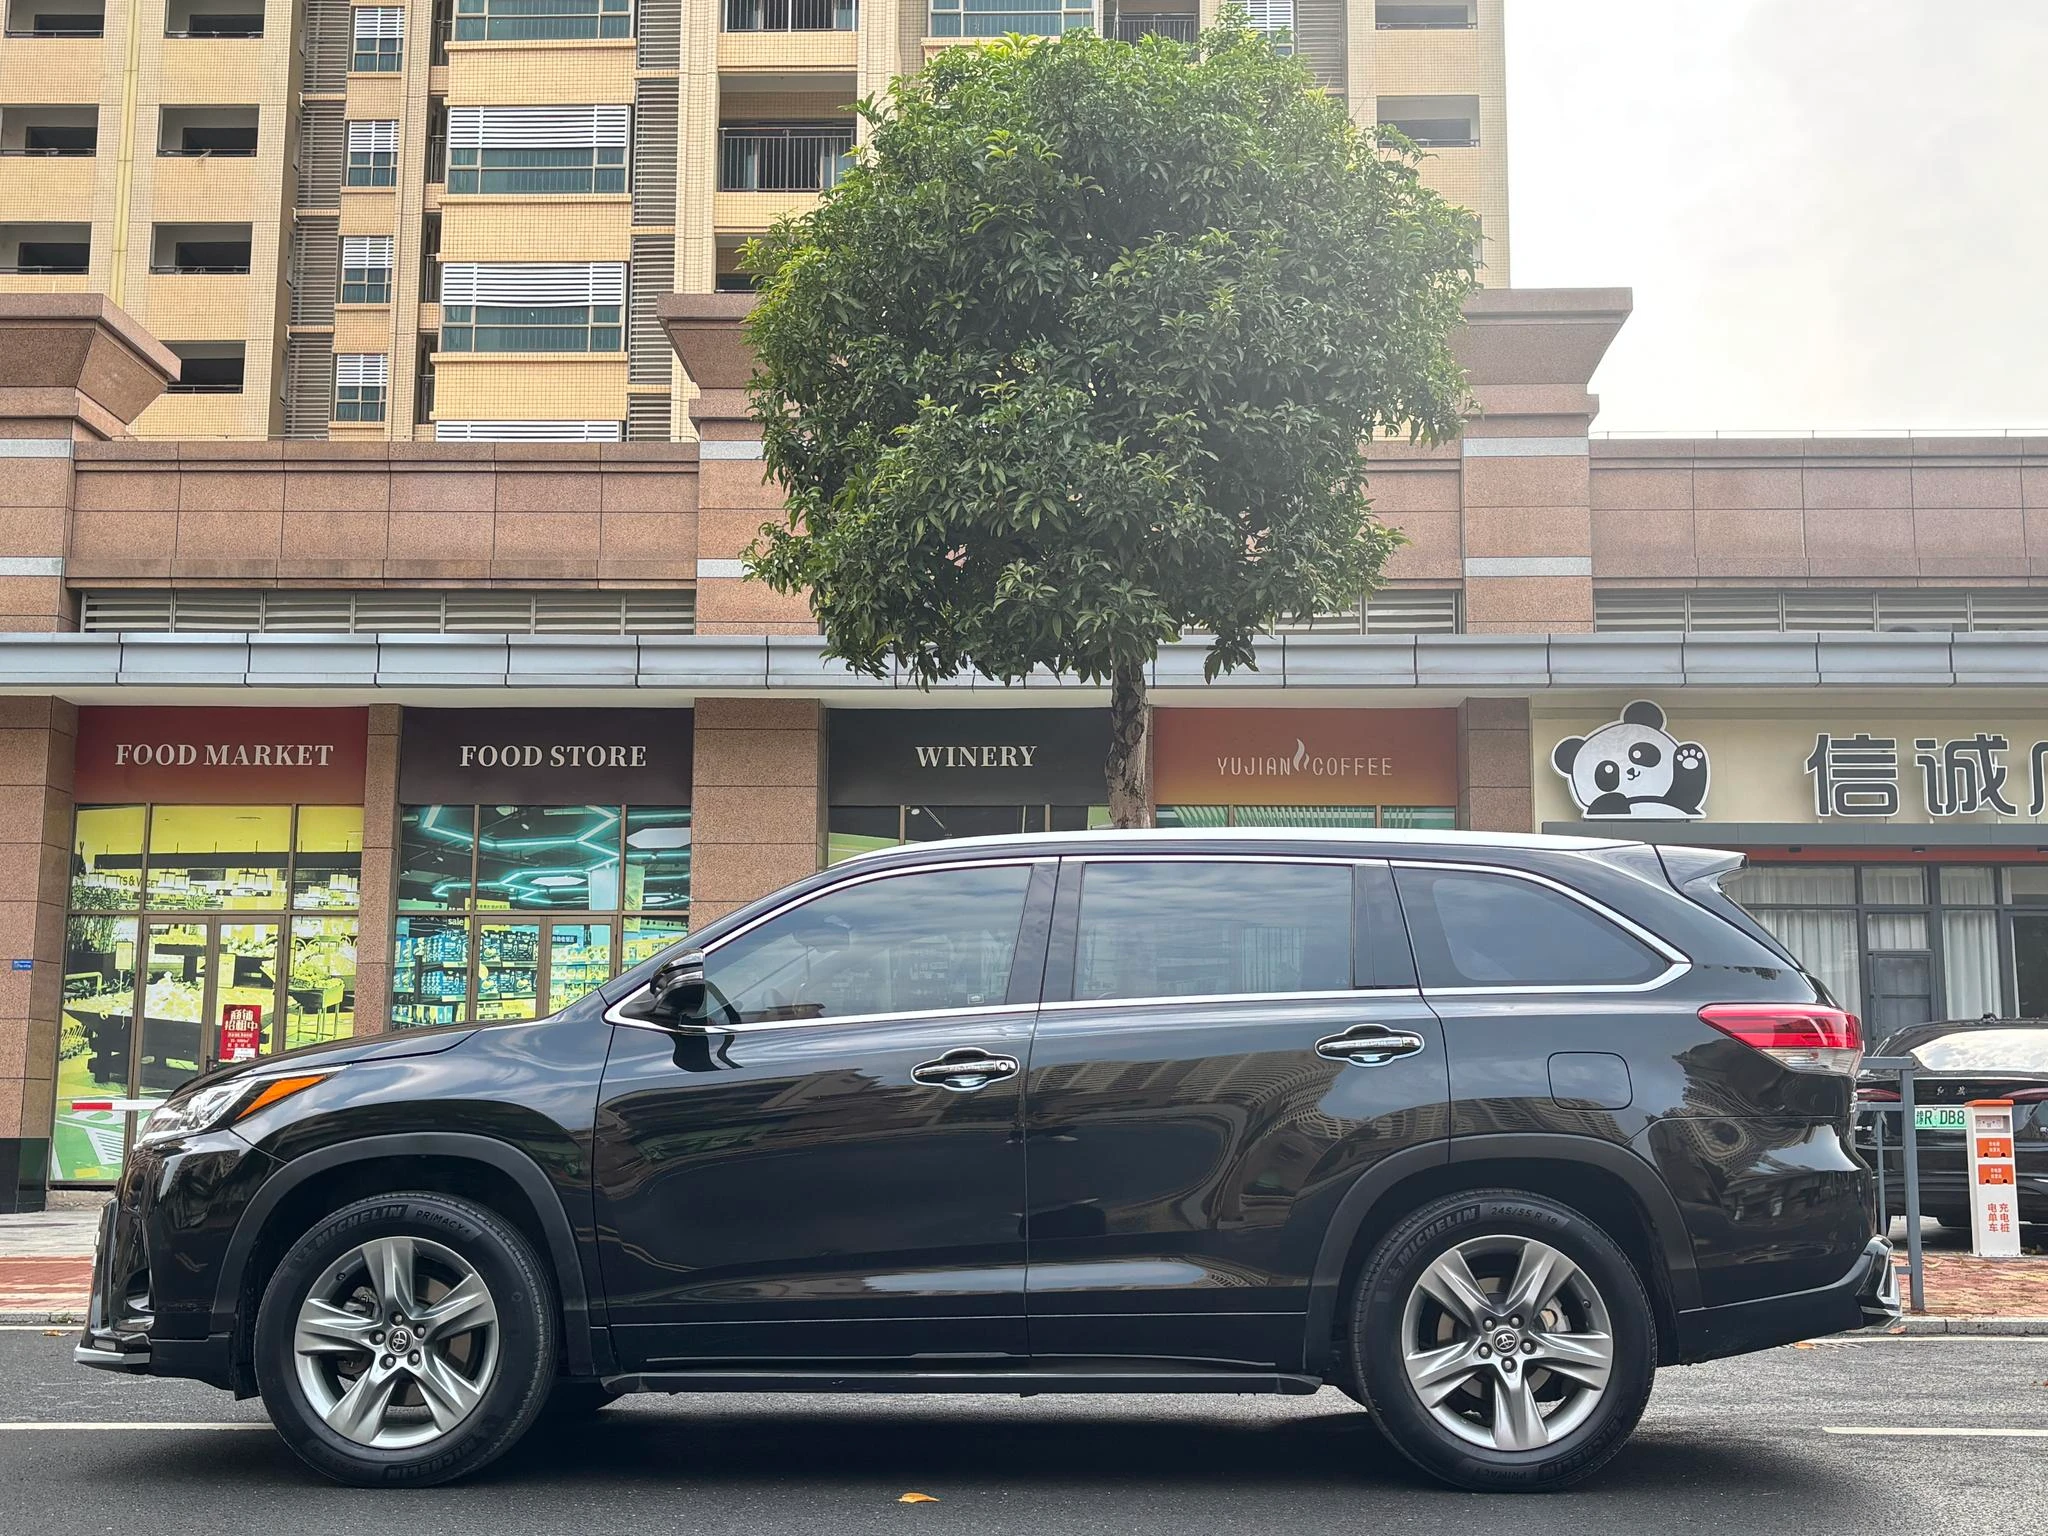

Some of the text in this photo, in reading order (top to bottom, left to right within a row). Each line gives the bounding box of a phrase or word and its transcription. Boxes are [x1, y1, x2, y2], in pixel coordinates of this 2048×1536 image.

[115, 743, 334, 766] FOOD MARKET
[459, 745, 647, 767] FOOD STORE
[915, 745, 1038, 767] WINERY
[1217, 757, 1393, 776] YUJIAN COFFEE
[1805, 733, 2048, 817] 信诚
[447, 917, 464, 926] sale
[316, 1206, 405, 1248] MICHELIN
[416, 1209, 465, 1231] PRIMACY
[1987, 1203, 1998, 1233] 电单车
[1999, 1203, 2010, 1233] 充电桩
[1398, 1206, 1559, 1266] MICHELIN 245/55 R 19
